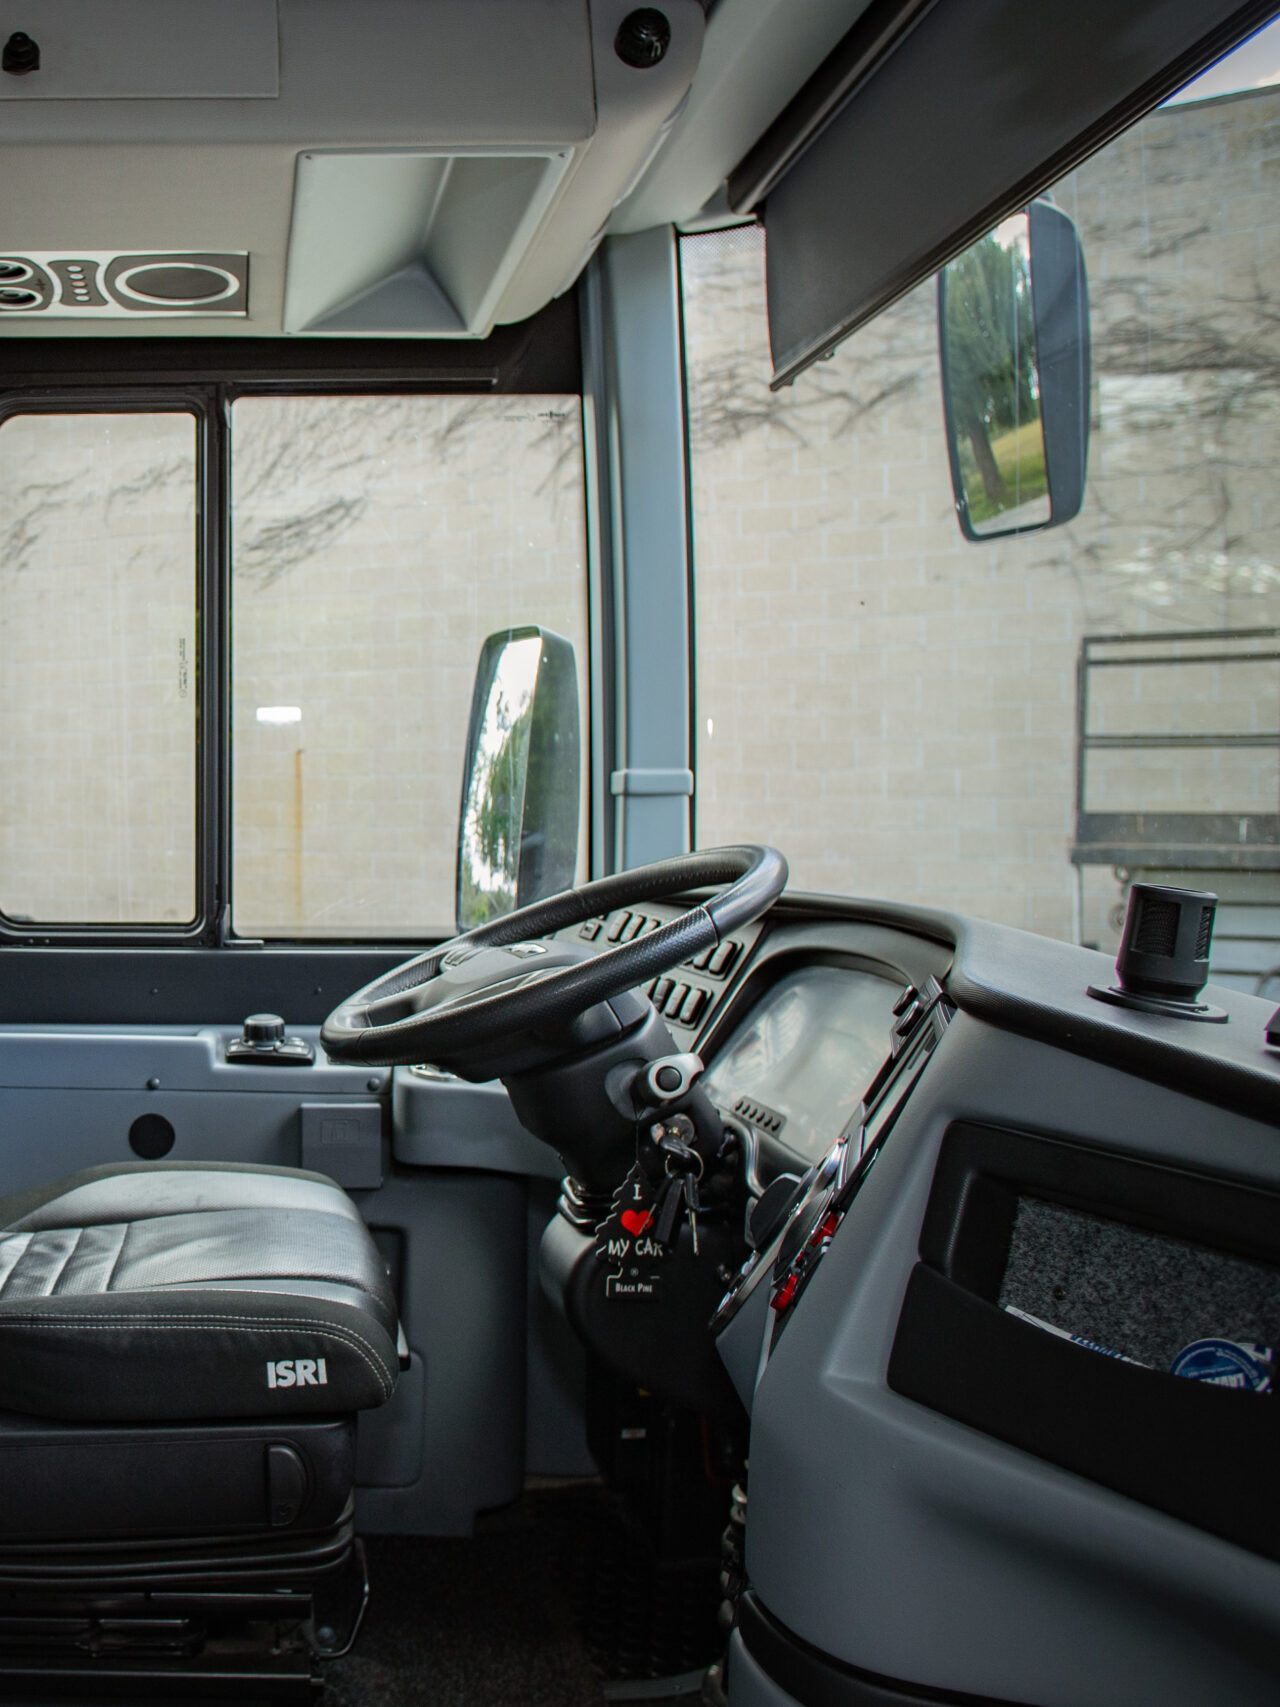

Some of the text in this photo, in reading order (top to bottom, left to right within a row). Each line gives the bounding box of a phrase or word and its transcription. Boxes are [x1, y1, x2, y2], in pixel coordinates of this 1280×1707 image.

[633, 1184, 642, 1200] I
[608, 1238, 630, 1258] MY
[266, 1358, 328, 1389] ISRI
